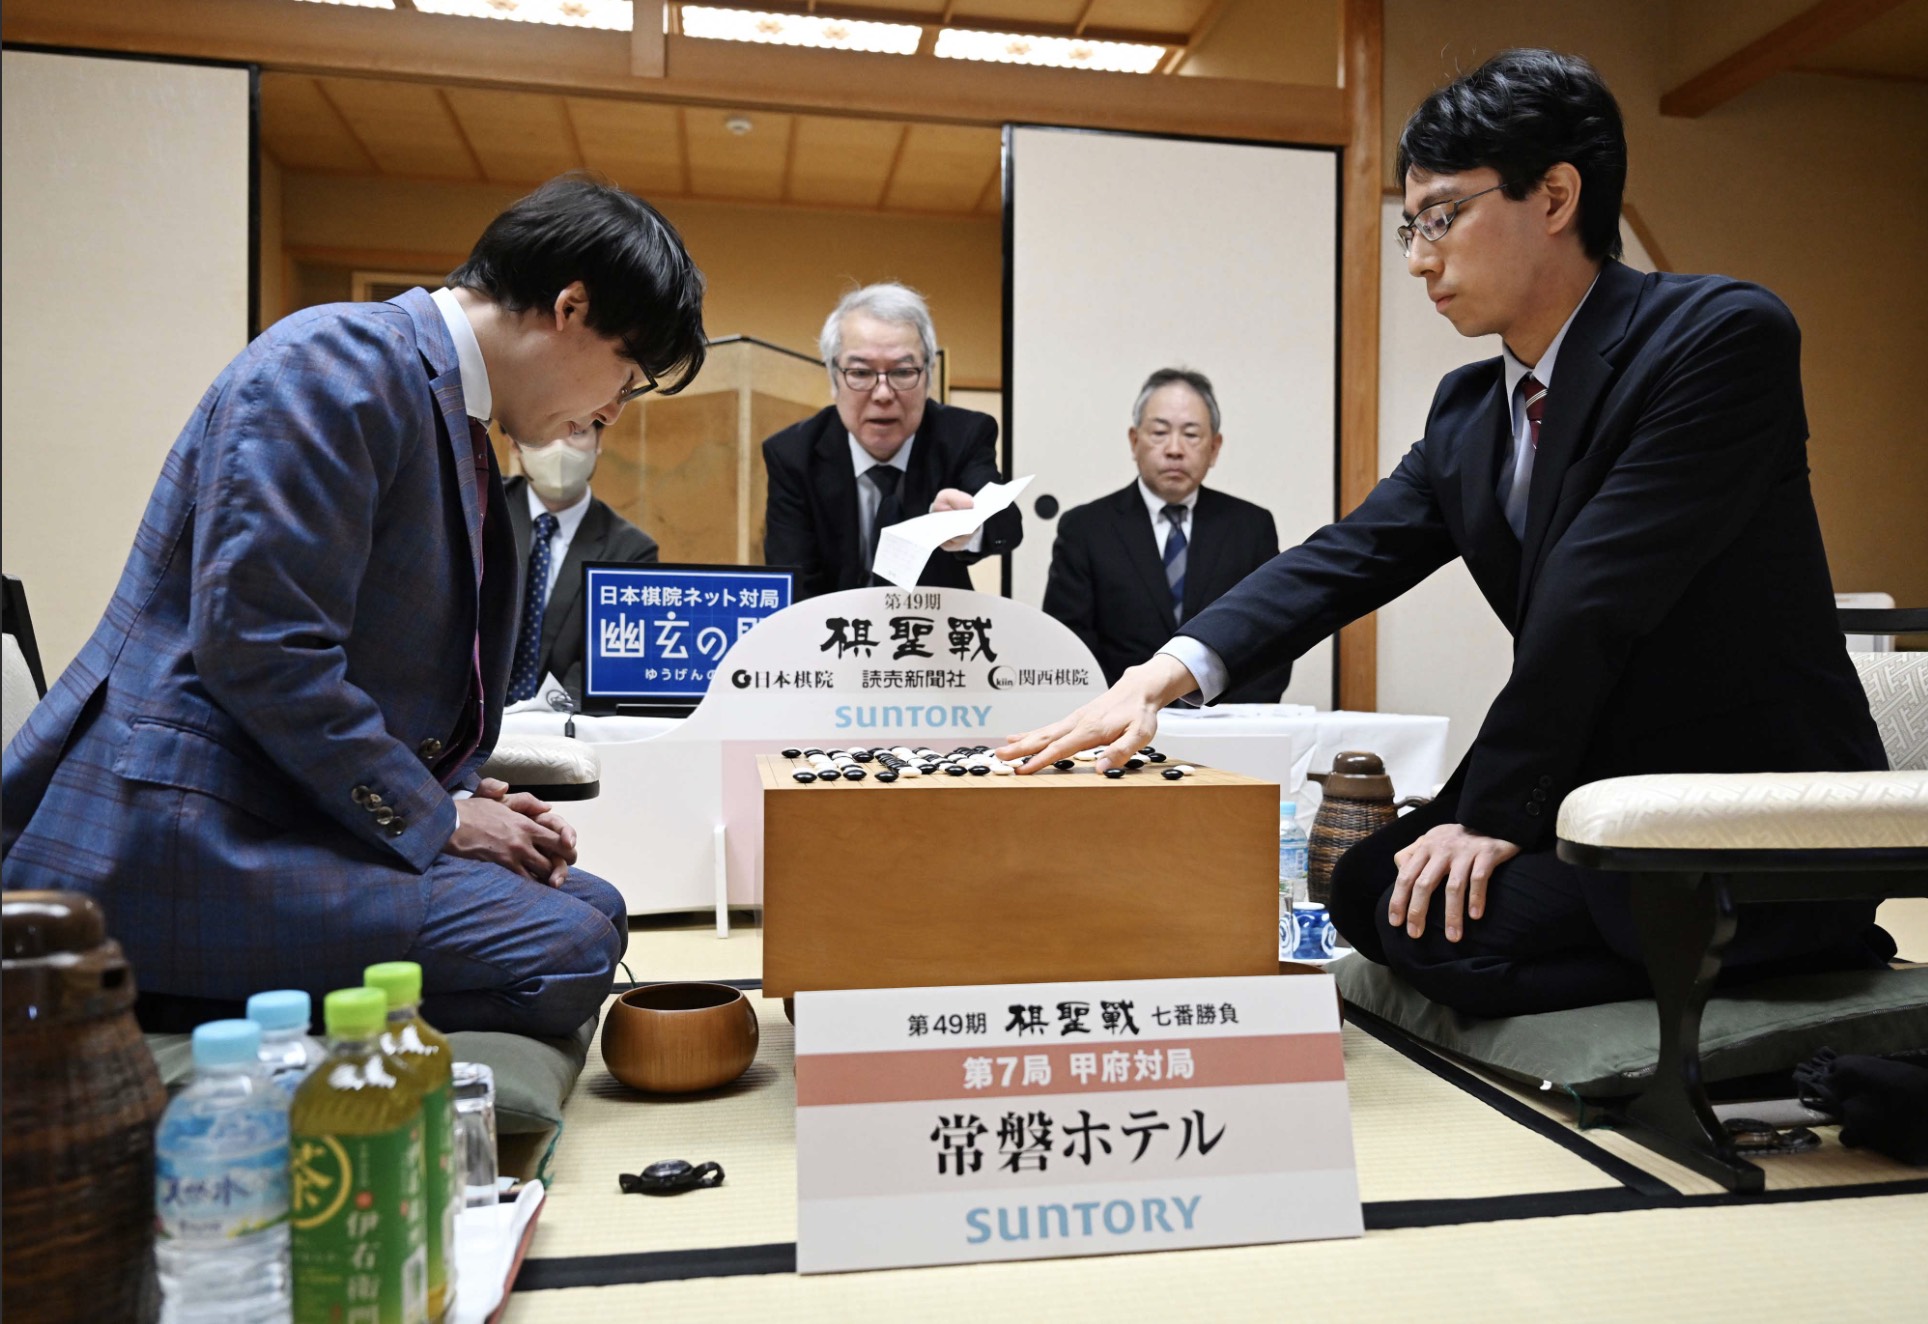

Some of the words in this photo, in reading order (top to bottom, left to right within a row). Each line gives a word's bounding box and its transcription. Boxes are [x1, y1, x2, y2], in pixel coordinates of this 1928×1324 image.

[600, 585, 780, 608] 日本棋院ネット対局
[885, 593, 941, 611] 第49期
[600, 611, 766, 661] 幽玄の
[755, 670, 834, 689] 日本棋院
[862, 669, 967, 689] 読売新聞社
[1018, 668, 1089, 686] 関西棋院
[835, 704, 993, 729] SUNTORY
[907, 1012, 987, 1036] 第49期
[1151, 1002, 1239, 1027] 七番勝負
[963, 1055, 1052, 1089] 第7局
[1069, 1048, 1194, 1085] 甲府対局
[929, 1109, 1226, 1176] 常磐ホテル
[966, 1195, 1202, 1245] SUNTORY
